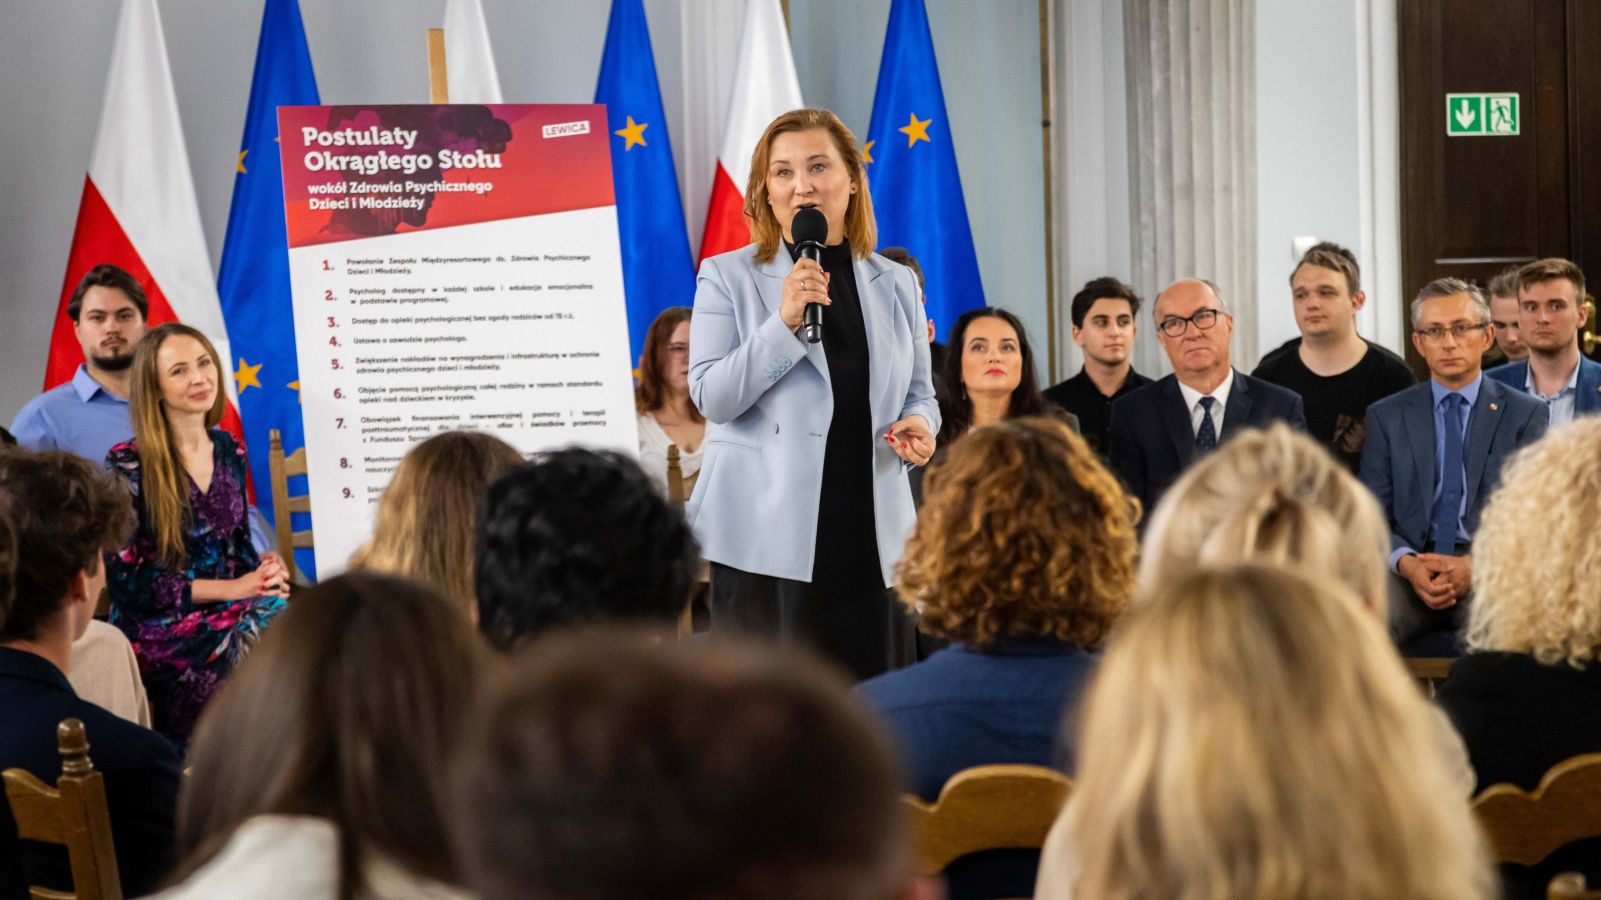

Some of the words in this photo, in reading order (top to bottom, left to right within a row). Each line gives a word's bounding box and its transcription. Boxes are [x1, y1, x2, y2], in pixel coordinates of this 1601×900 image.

[545, 123, 587, 136] LEWICA
[302, 126, 417, 149] Postulaty
[304, 151, 433, 174] Okrągłego
[438, 150, 502, 169] Stołu
[308, 182, 347, 194] wokół
[349, 181, 402, 194] Zdrowia
[405, 180, 493, 195] Psychicznego
[309, 198, 349, 209] Dzieci
[352, 197, 357, 208] i
[359, 196, 425, 210] Młodzieży
[323, 260, 335, 271] 1.
[388, 257, 417, 266] Zespołu
[421, 255, 491, 265] Międzyresortowego
[543, 253, 591, 263] Psychicznego
[347, 268, 370, 276] Dzieci
[375, 267, 413, 275] Młodzieży.
[324, 289, 338, 301] 2.
[349, 287, 386, 296] Psycholog
[391, 286, 426, 295] dostępny
[443, 284, 468, 294] każdej
[473, 284, 495, 292] szkole
[509, 284, 542, 292] edukacja
[547, 283, 594, 291] emocjonalna
[360, 296, 398, 305] podstawie
[399, 295, 449, 305] programowej.
[327, 316, 340, 328] 3.
[351, 316, 378, 326] Dostęp
[379, 316, 389, 325] do
[391, 315, 413, 325] opieki
[414, 312, 472, 324] psychologicznej
[473, 314, 486, 322] bez
[488, 313, 510, 322] zgody
[511, 312, 543, 321] rodziców
[544, 312, 554, 320] od
[329, 336, 342, 348] 4.
[353, 337, 380, 345] Ustawa
[389, 335, 423, 344] zawodzie
[424, 333, 467, 344] psychologa.
[331, 358, 344, 370] 5.
[355, 356, 399, 365] Zwiększenie
[400, 354, 436, 363] nakładów
[450, 352, 505, 362] wynagrodzenia
[511, 351, 559, 360] infrastrukturę
[569, 350, 600, 358] ochronie
[356, 366, 385, 374] zdrowia
[386, 364, 436, 374] psychicznego
[437, 363, 459, 372] dzieci
[463, 362, 501, 371] młodzieży.
[358, 385, 386, 394] Objęcie
[389, 384, 419, 393] pomocą
[421, 382, 477, 393] psychologiczną
[479, 382, 497, 391] całej
[499, 380, 526, 390] rodziny
[537, 380, 564, 388] ramach
[566, 379, 604, 387] standardu
[333, 387, 346, 400] 6.
[359, 396, 382, 404] opieki
[383, 394, 398, 402] nad
[399, 393, 436, 402] dzieckiem
[445, 392, 476, 401] kryzysie.
[335, 416, 348, 429] 7.
[361, 415, 402, 424] Obowiązek
[411, 413, 461, 422] finansowania
[469, 411, 523, 421] interwencyjnej
[532, 410, 562, 418] pomocy
[361, 424, 430, 434] posttraumatycznej
[530, 419, 566, 428] świadków
[572, 418, 607, 427] przemocy
[369, 435, 405, 443] Funduszu
[339, 457, 353, 469] 8.
[342, 487, 355, 499] 9.
